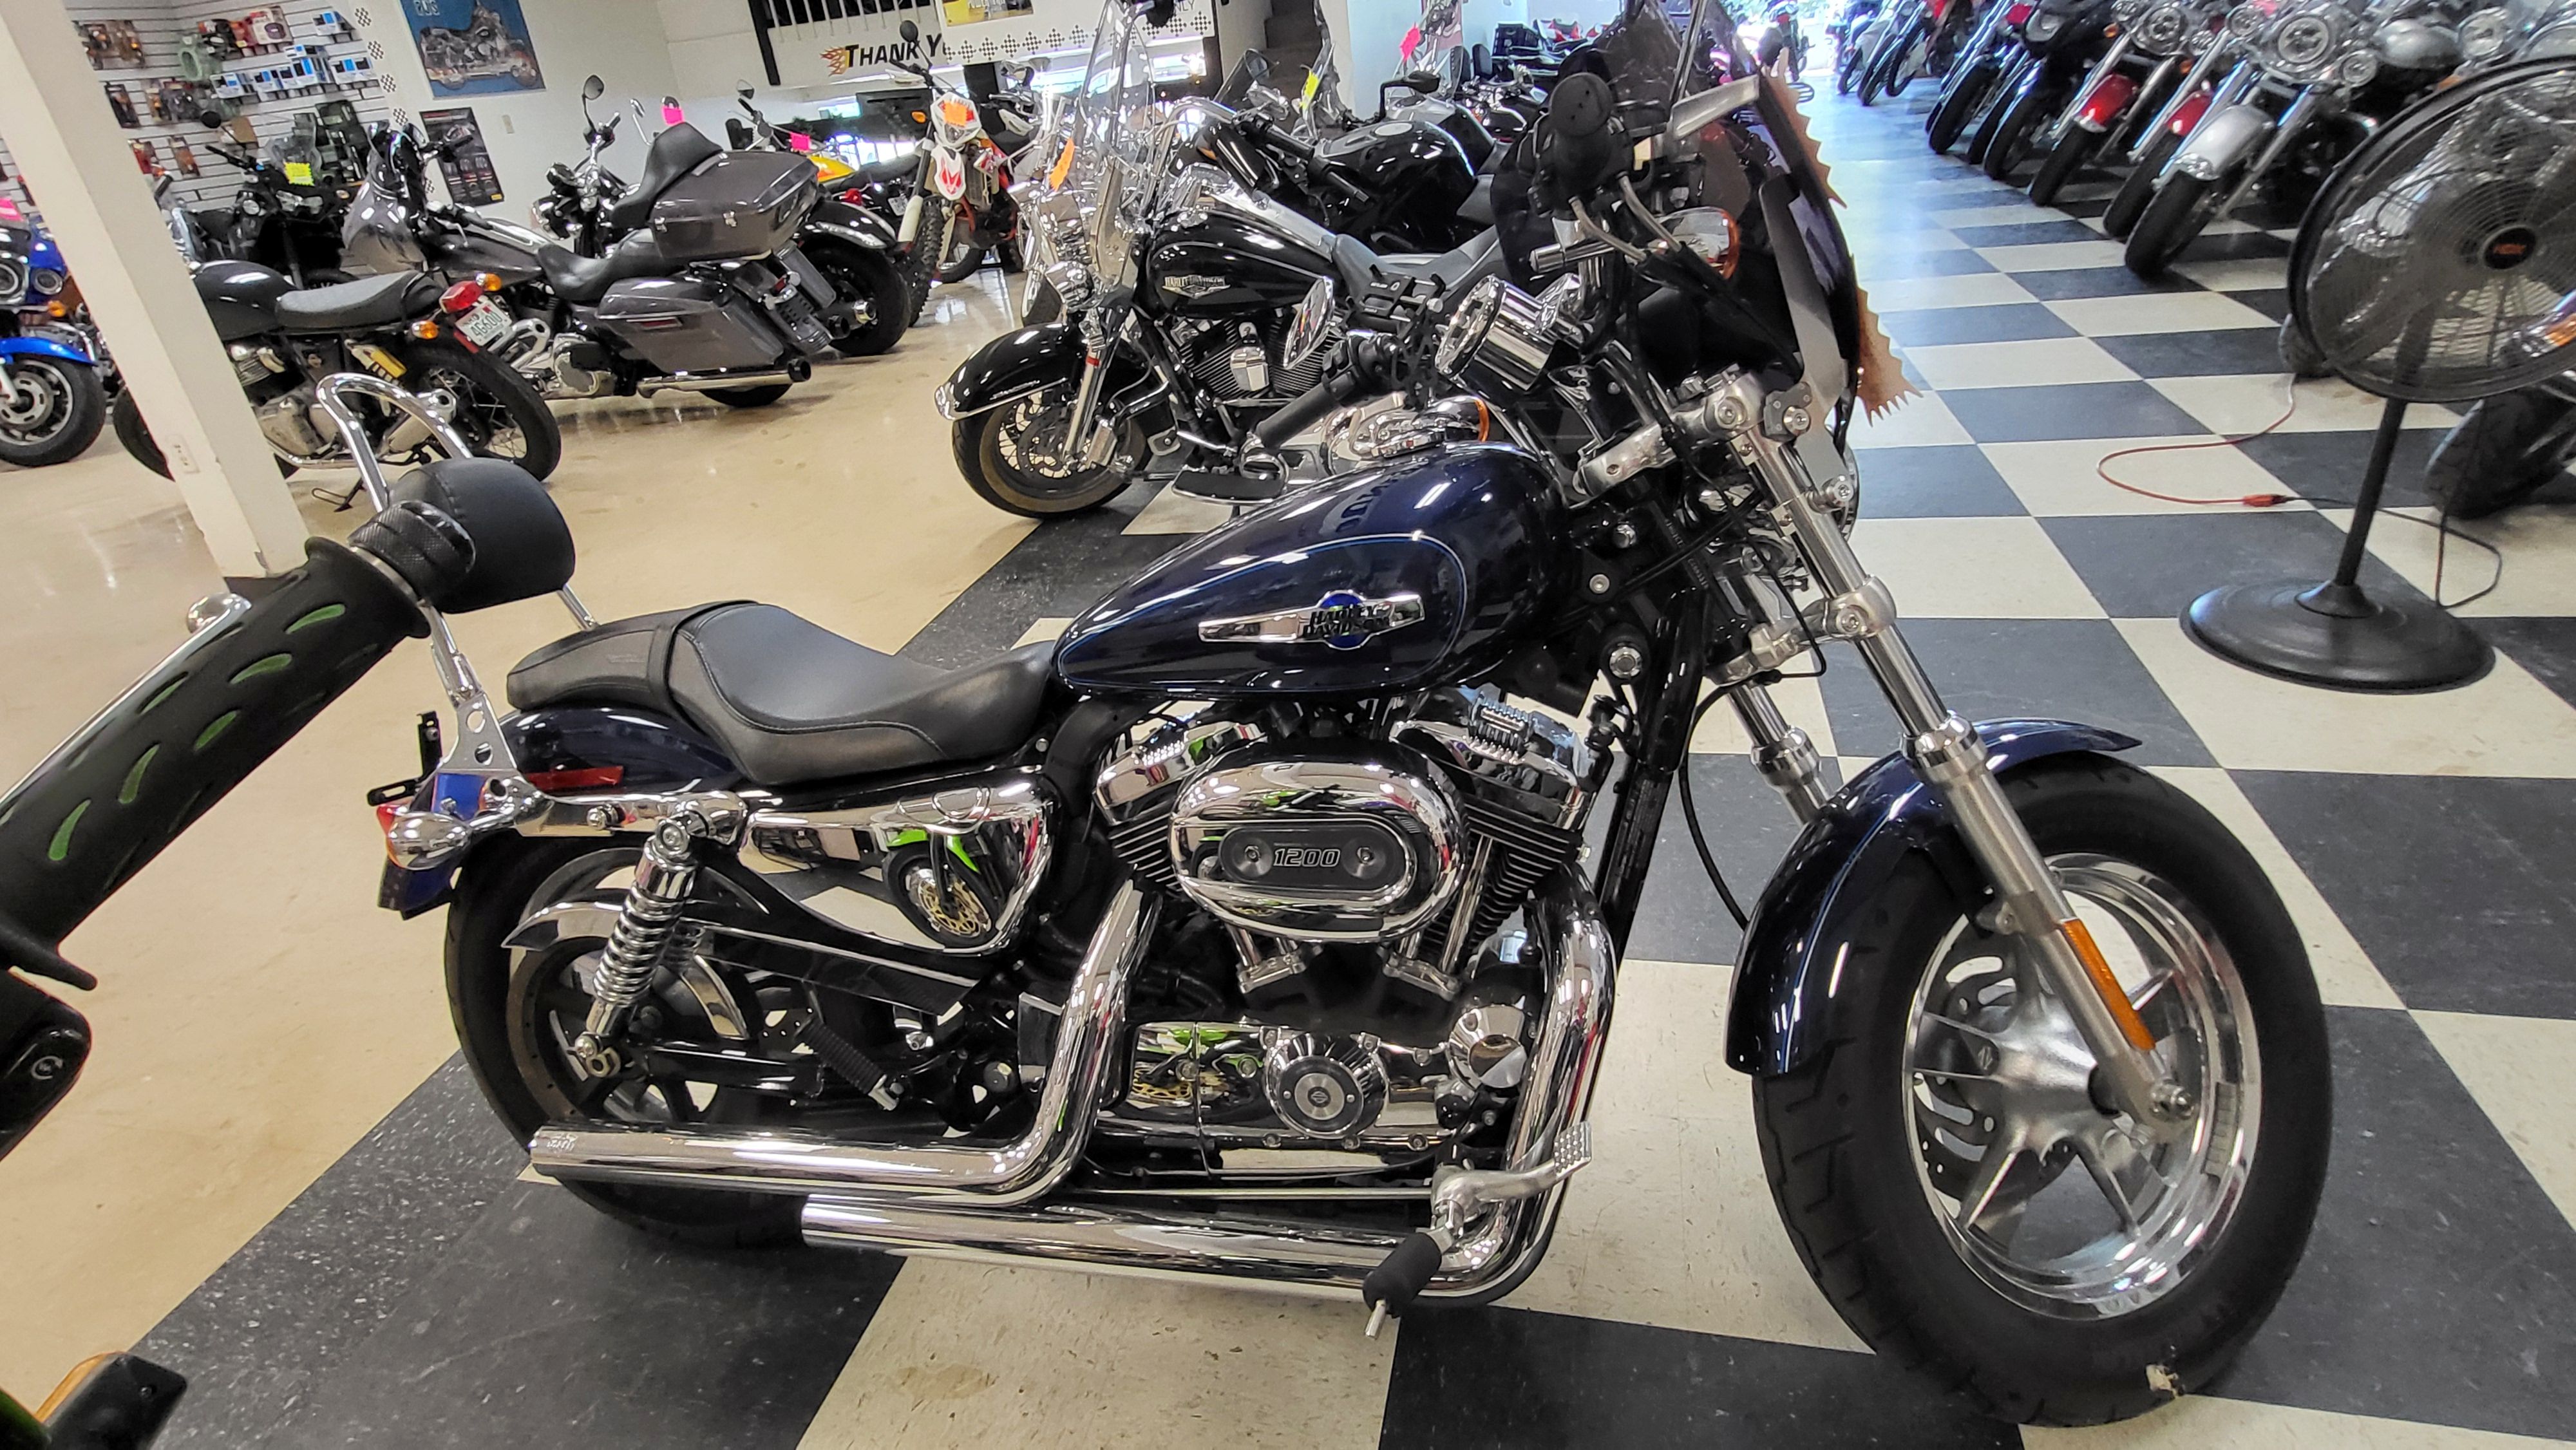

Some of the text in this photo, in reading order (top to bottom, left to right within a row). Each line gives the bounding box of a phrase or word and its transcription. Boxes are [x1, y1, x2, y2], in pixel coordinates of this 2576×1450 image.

[845, 33, 947, 68] THANK Y
[1274, 849, 1340, 867] 1200
